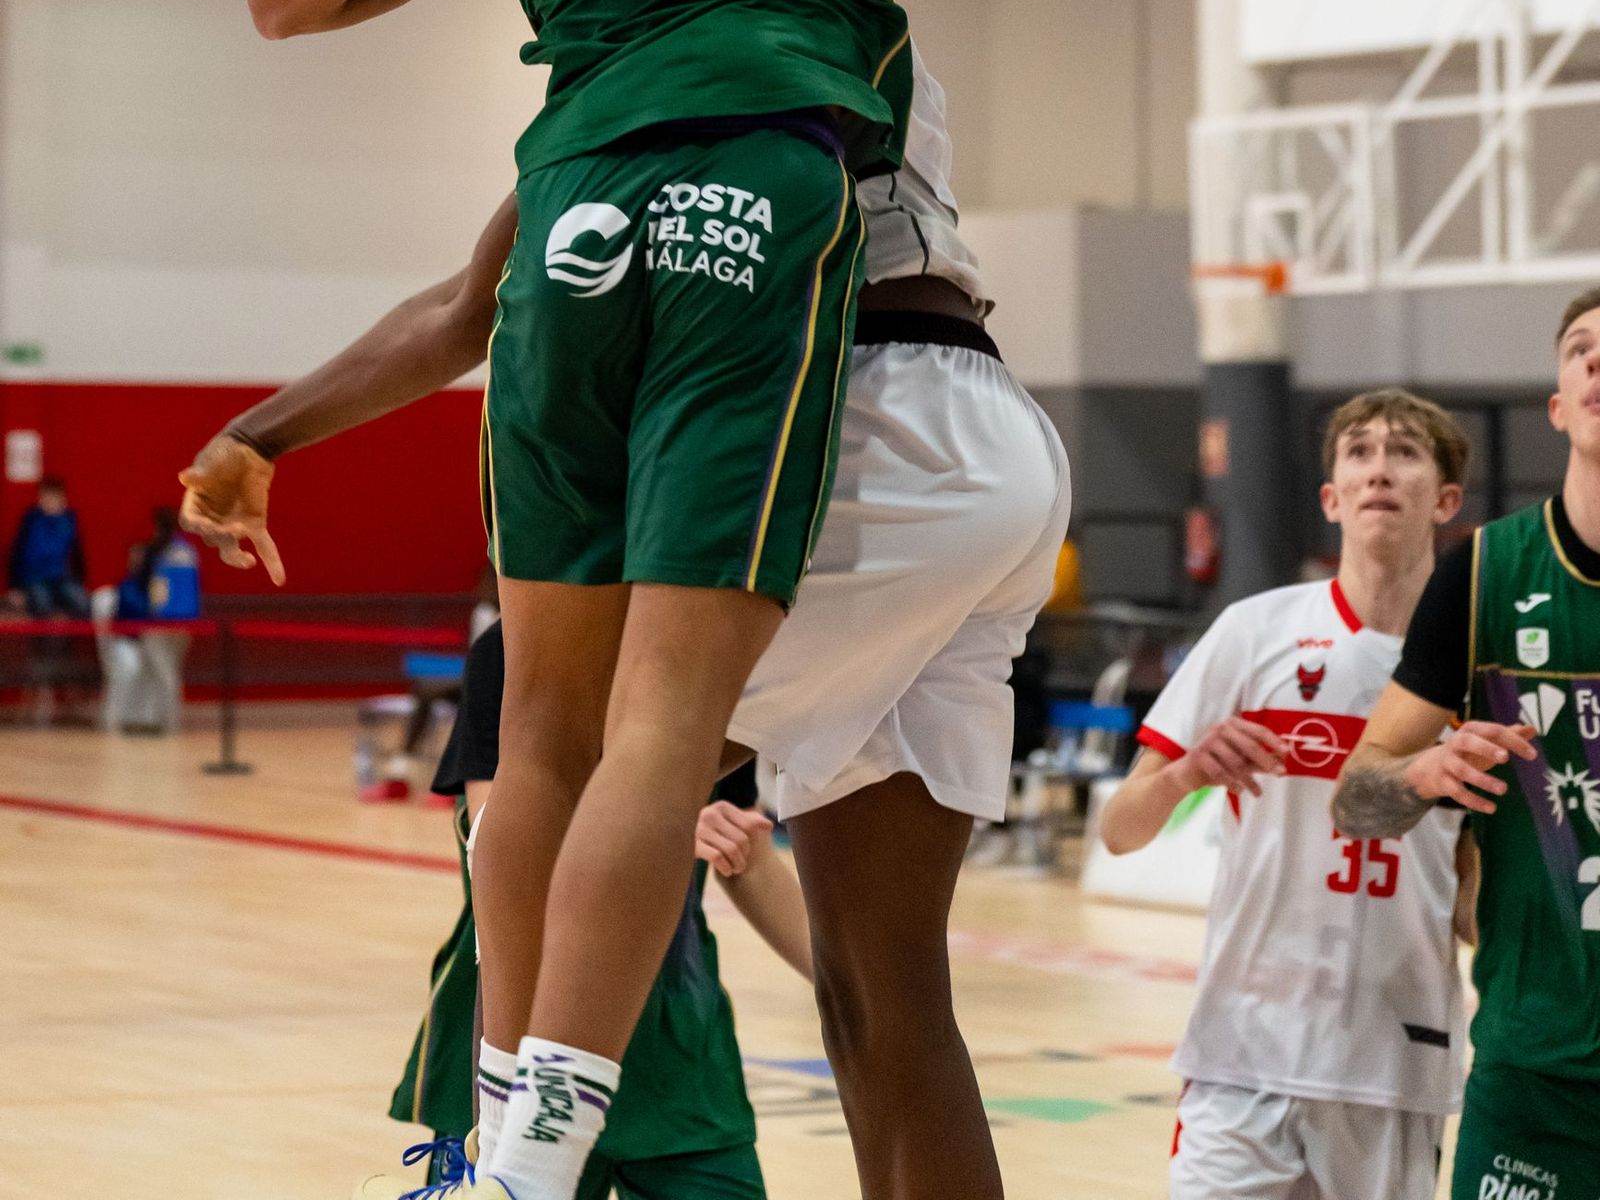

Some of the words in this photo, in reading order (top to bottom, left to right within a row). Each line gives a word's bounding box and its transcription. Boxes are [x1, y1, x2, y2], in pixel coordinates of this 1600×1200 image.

[647, 182, 773, 234] COSTA
[700, 218, 765, 264] SOL
[1326, 827, 1402, 899] 35
